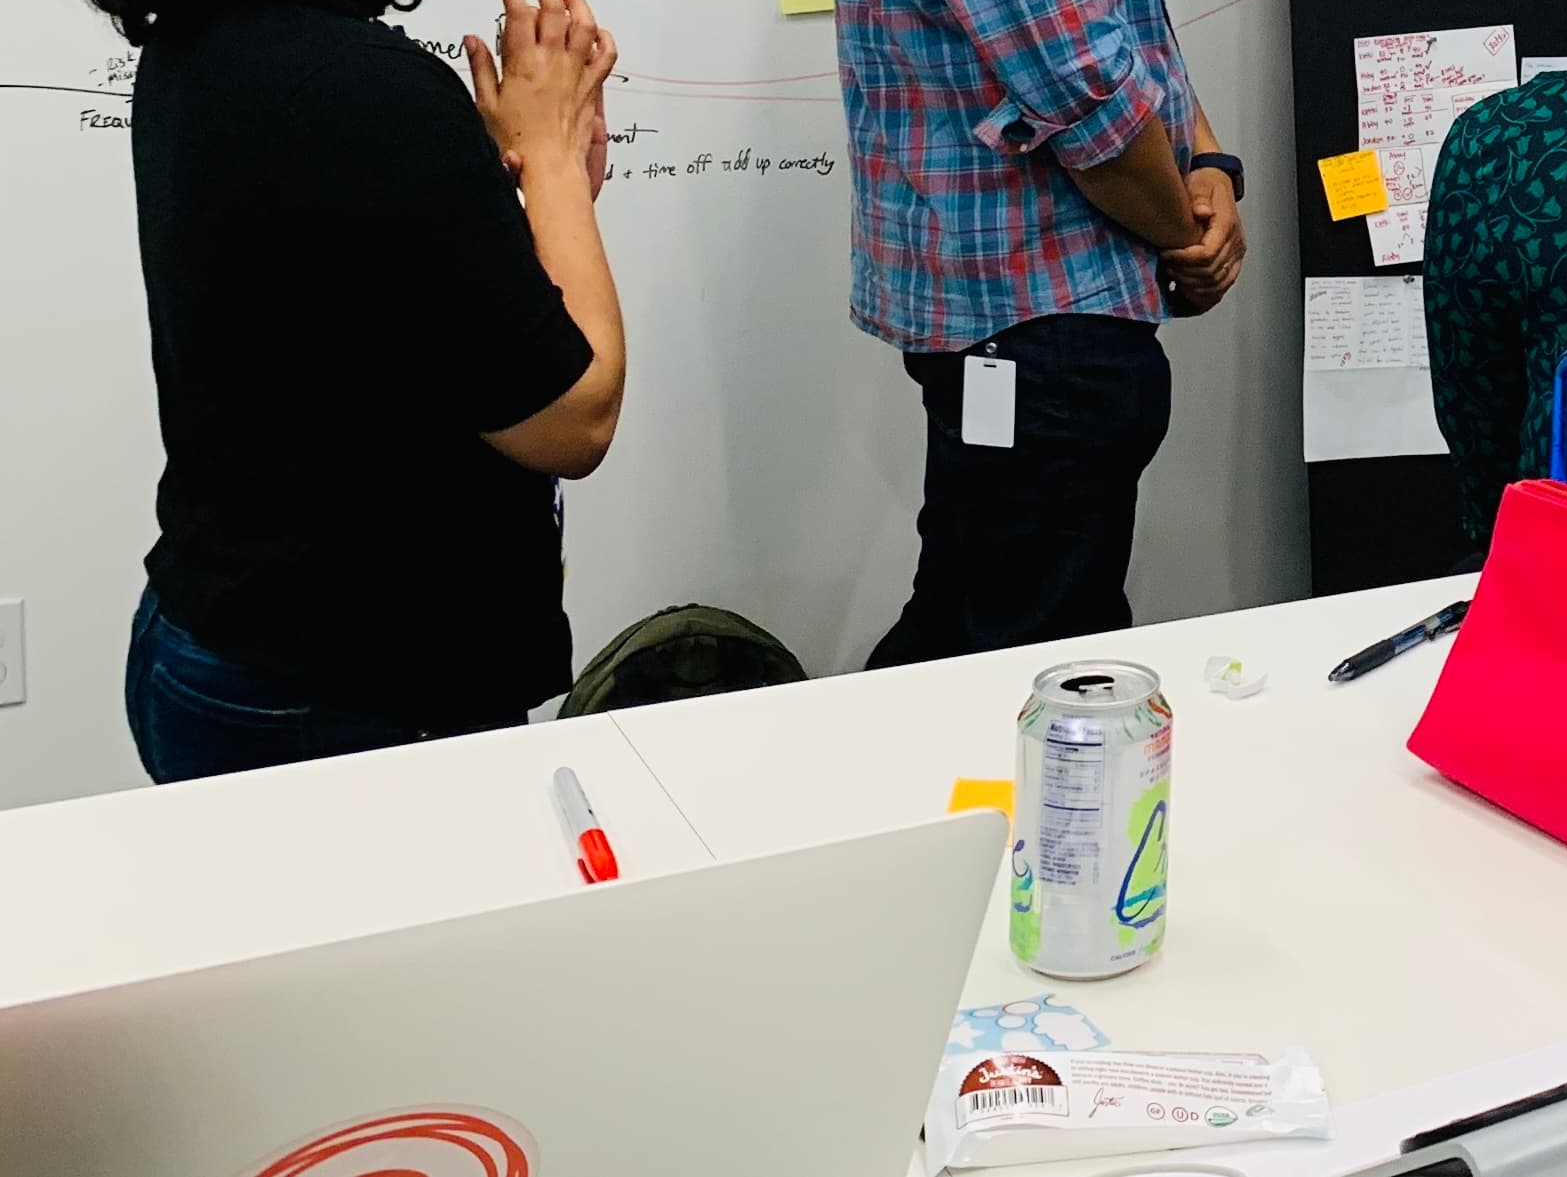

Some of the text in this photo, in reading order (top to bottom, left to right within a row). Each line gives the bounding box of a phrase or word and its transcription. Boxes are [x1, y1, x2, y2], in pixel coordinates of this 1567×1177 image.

[642, 165, 676, 179] time
[687, 154, 712, 174] off
[756, 159, 771, 176] up
[778, 152, 835, 175] correctly
